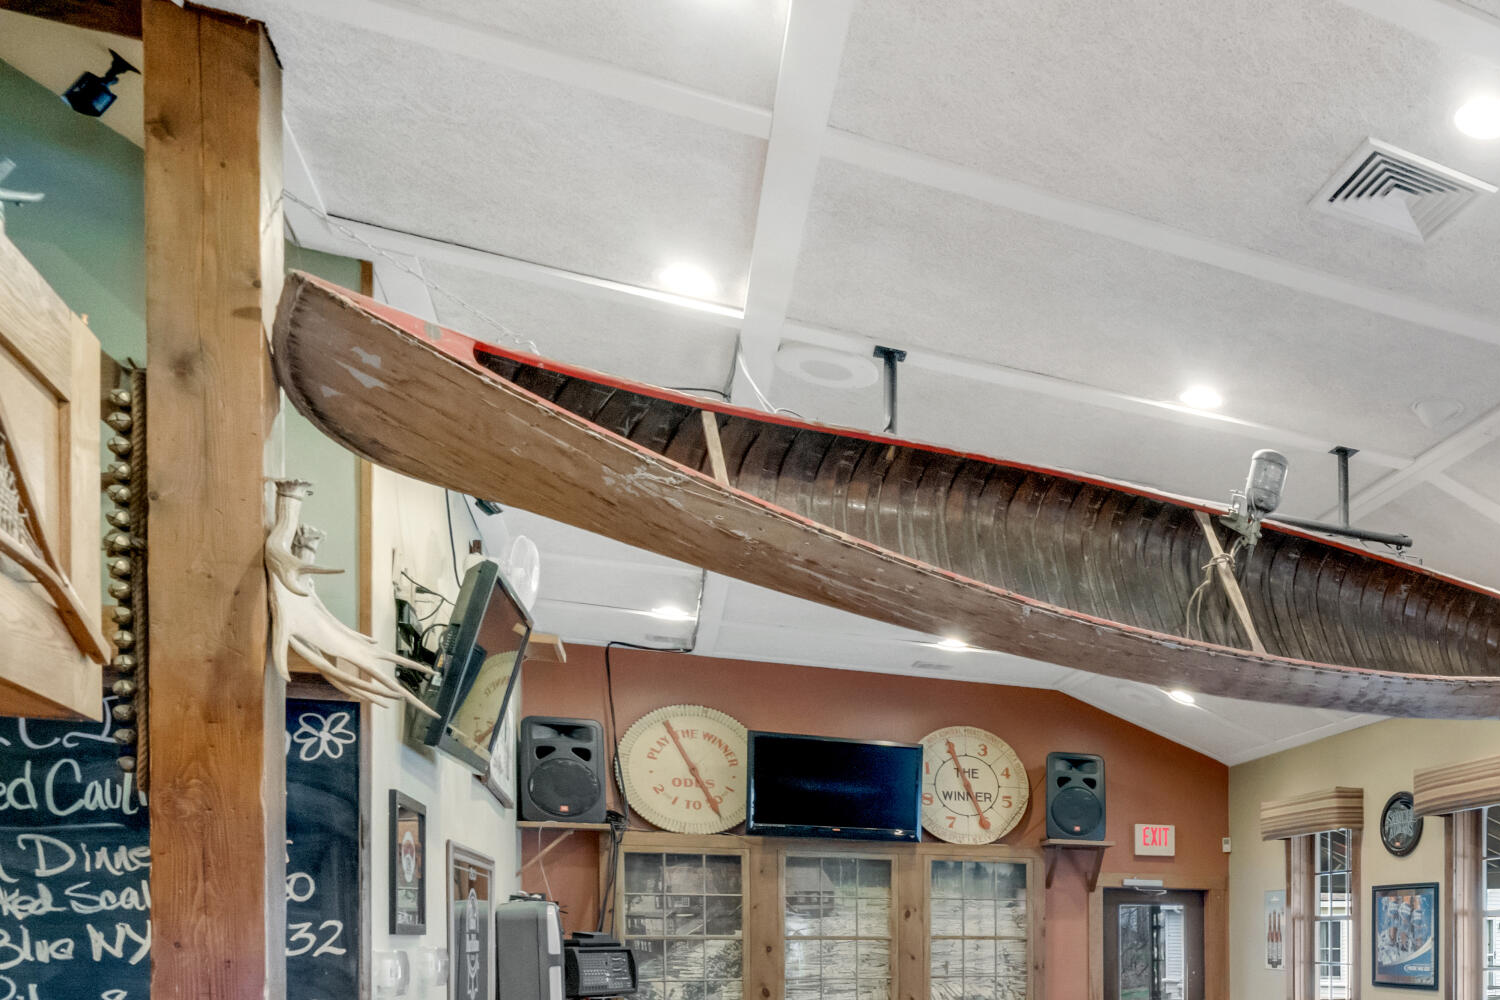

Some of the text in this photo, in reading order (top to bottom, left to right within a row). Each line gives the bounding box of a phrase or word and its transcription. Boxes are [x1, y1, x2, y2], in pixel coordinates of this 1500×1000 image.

[647, 728, 740, 768] PLAY HE WINNER
[977, 743, 988, 757] 3
[924, 761, 931, 775] 1
[953, 766, 980, 780] THE
[1000, 767, 1011, 780] 4
[922, 792, 934, 806] 8
[941, 790, 993, 804] WINNER
[1001, 795, 1013, 809] 5
[945, 815, 957, 829] 7
[1142, 826, 1169, 847] EXIT
